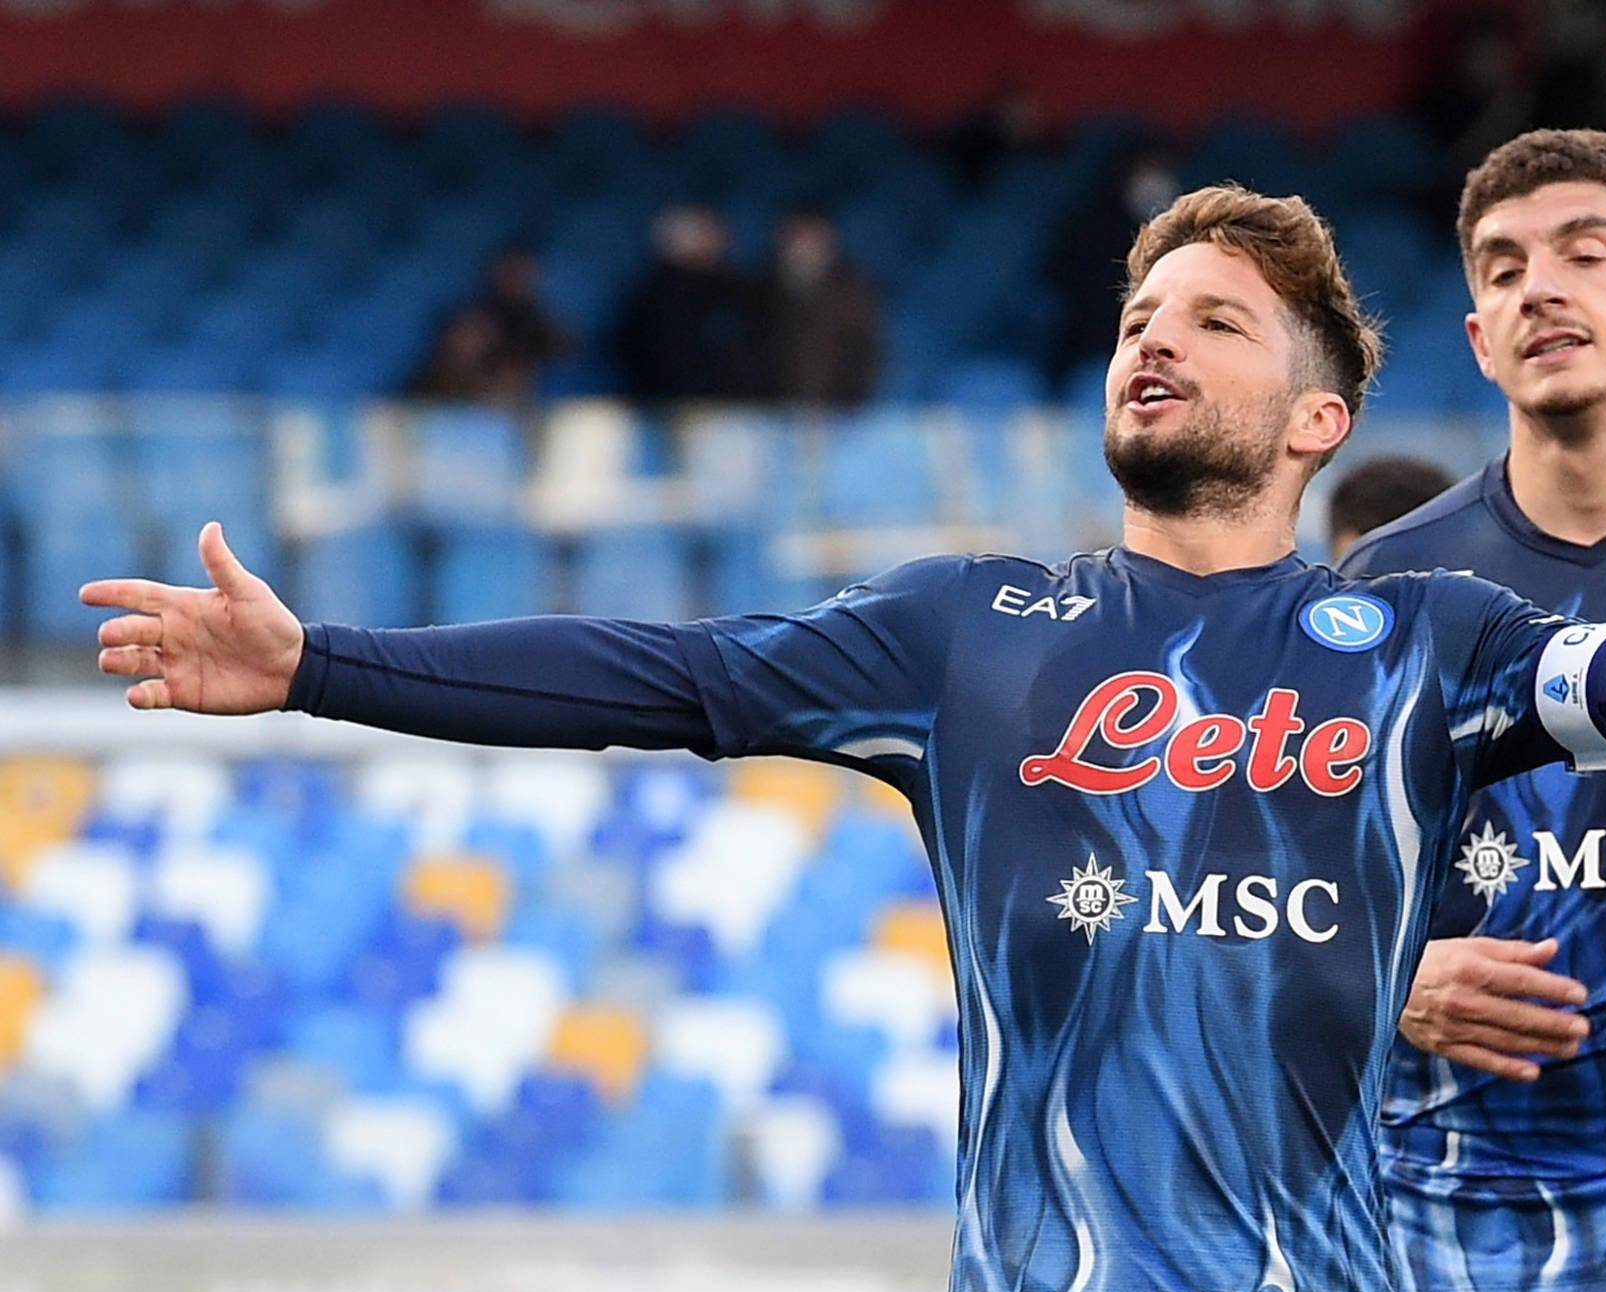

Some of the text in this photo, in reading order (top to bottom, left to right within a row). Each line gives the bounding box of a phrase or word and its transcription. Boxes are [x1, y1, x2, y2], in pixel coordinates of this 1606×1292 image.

[991, 584, 1097, 621] EA7
[1323, 605, 1369, 637] N
[1019, 670, 1372, 797] Lete
[1142, 869, 1340, 944] MSC
